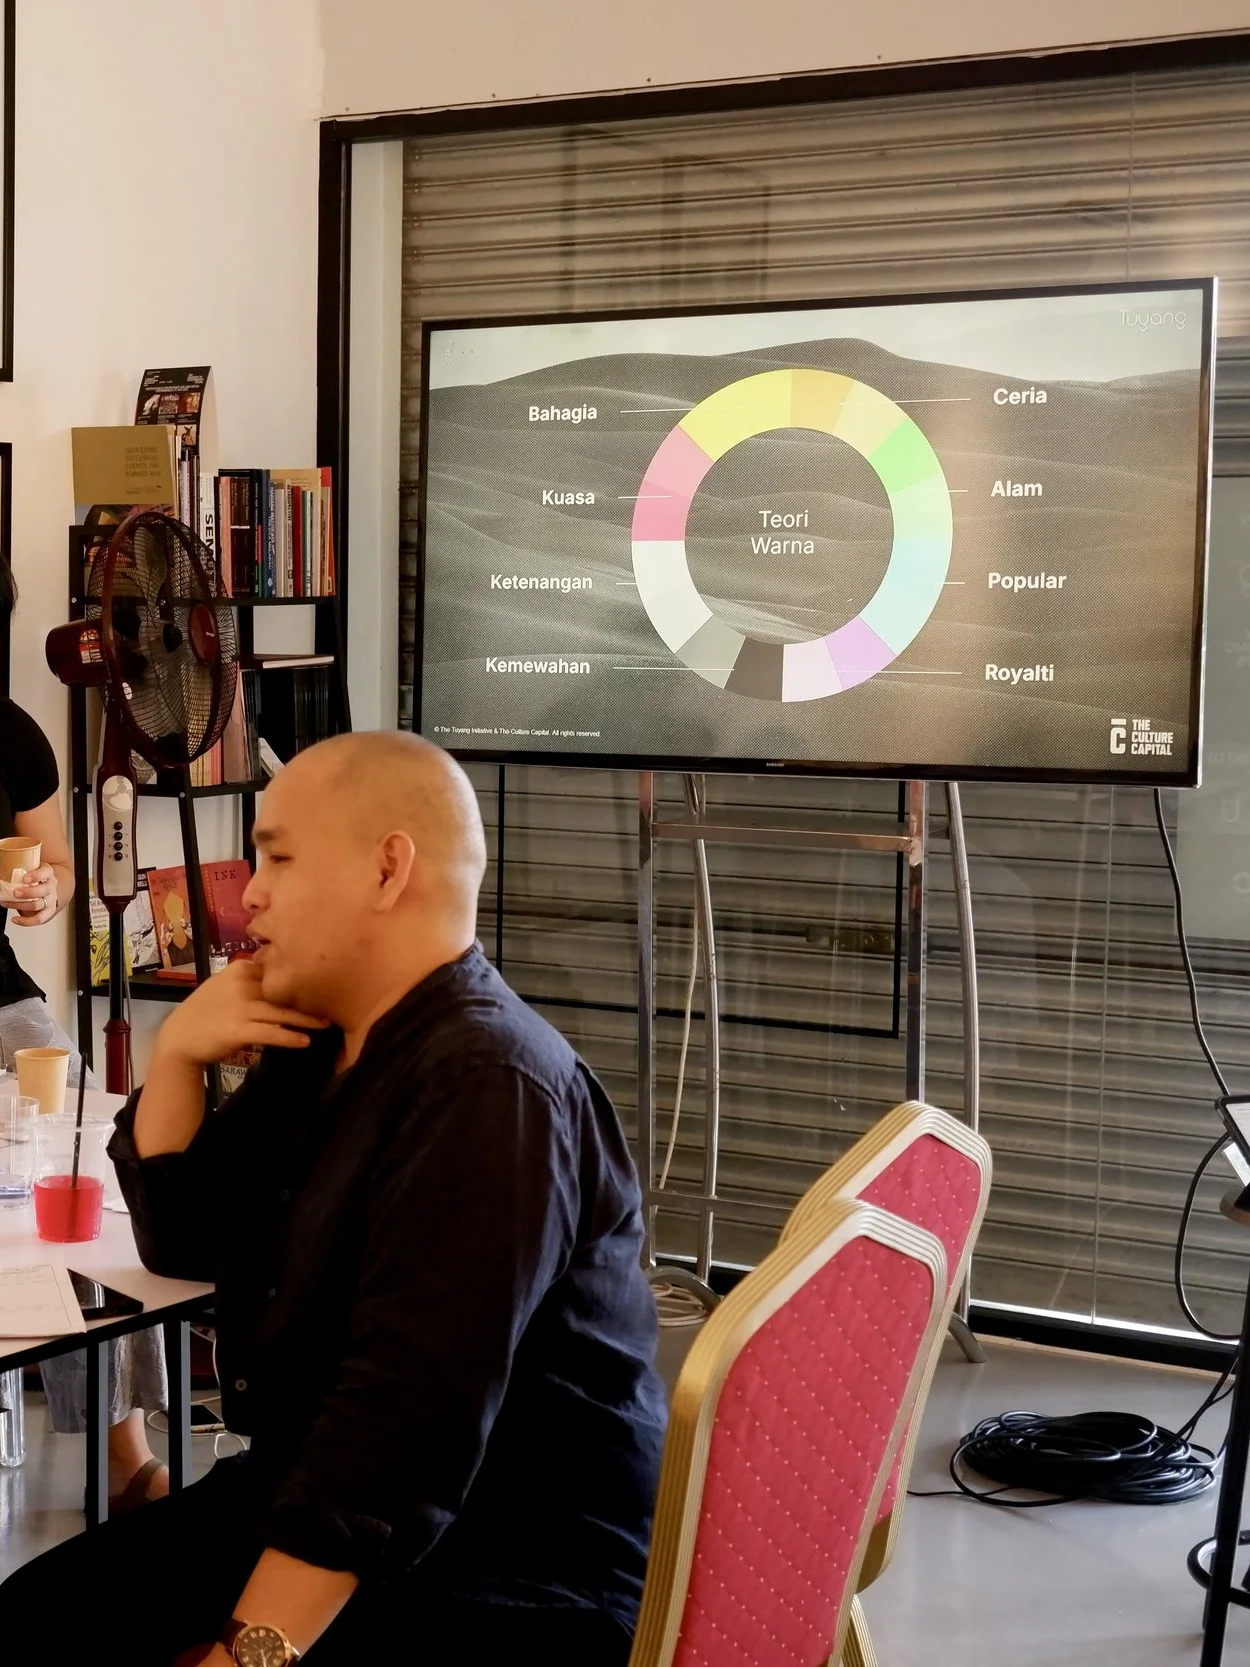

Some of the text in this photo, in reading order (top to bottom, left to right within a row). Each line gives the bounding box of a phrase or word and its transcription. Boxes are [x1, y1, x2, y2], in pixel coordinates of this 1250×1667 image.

[1119, 309, 1188, 332] Tuyang
[994, 386, 1047, 405] Ceria
[528, 403, 598, 424] Bahagia
[542, 490, 595, 505] Kuasa
[990, 480, 1043, 497] Alam
[758, 510, 808, 528] Teori
[751, 536, 814, 554] Warna
[490, 574, 592, 593] Ketenangan
[988, 572, 1067, 593] Popular
[485, 657, 590, 674] Kemewahan
[985, 664, 1054, 685] Royalti
[1132, 719, 1150, 731] THE
[1131, 731, 1174, 743] CULTURE
[1131, 743, 1172, 755] CAPITAL
[214, 869, 237, 881] INK
